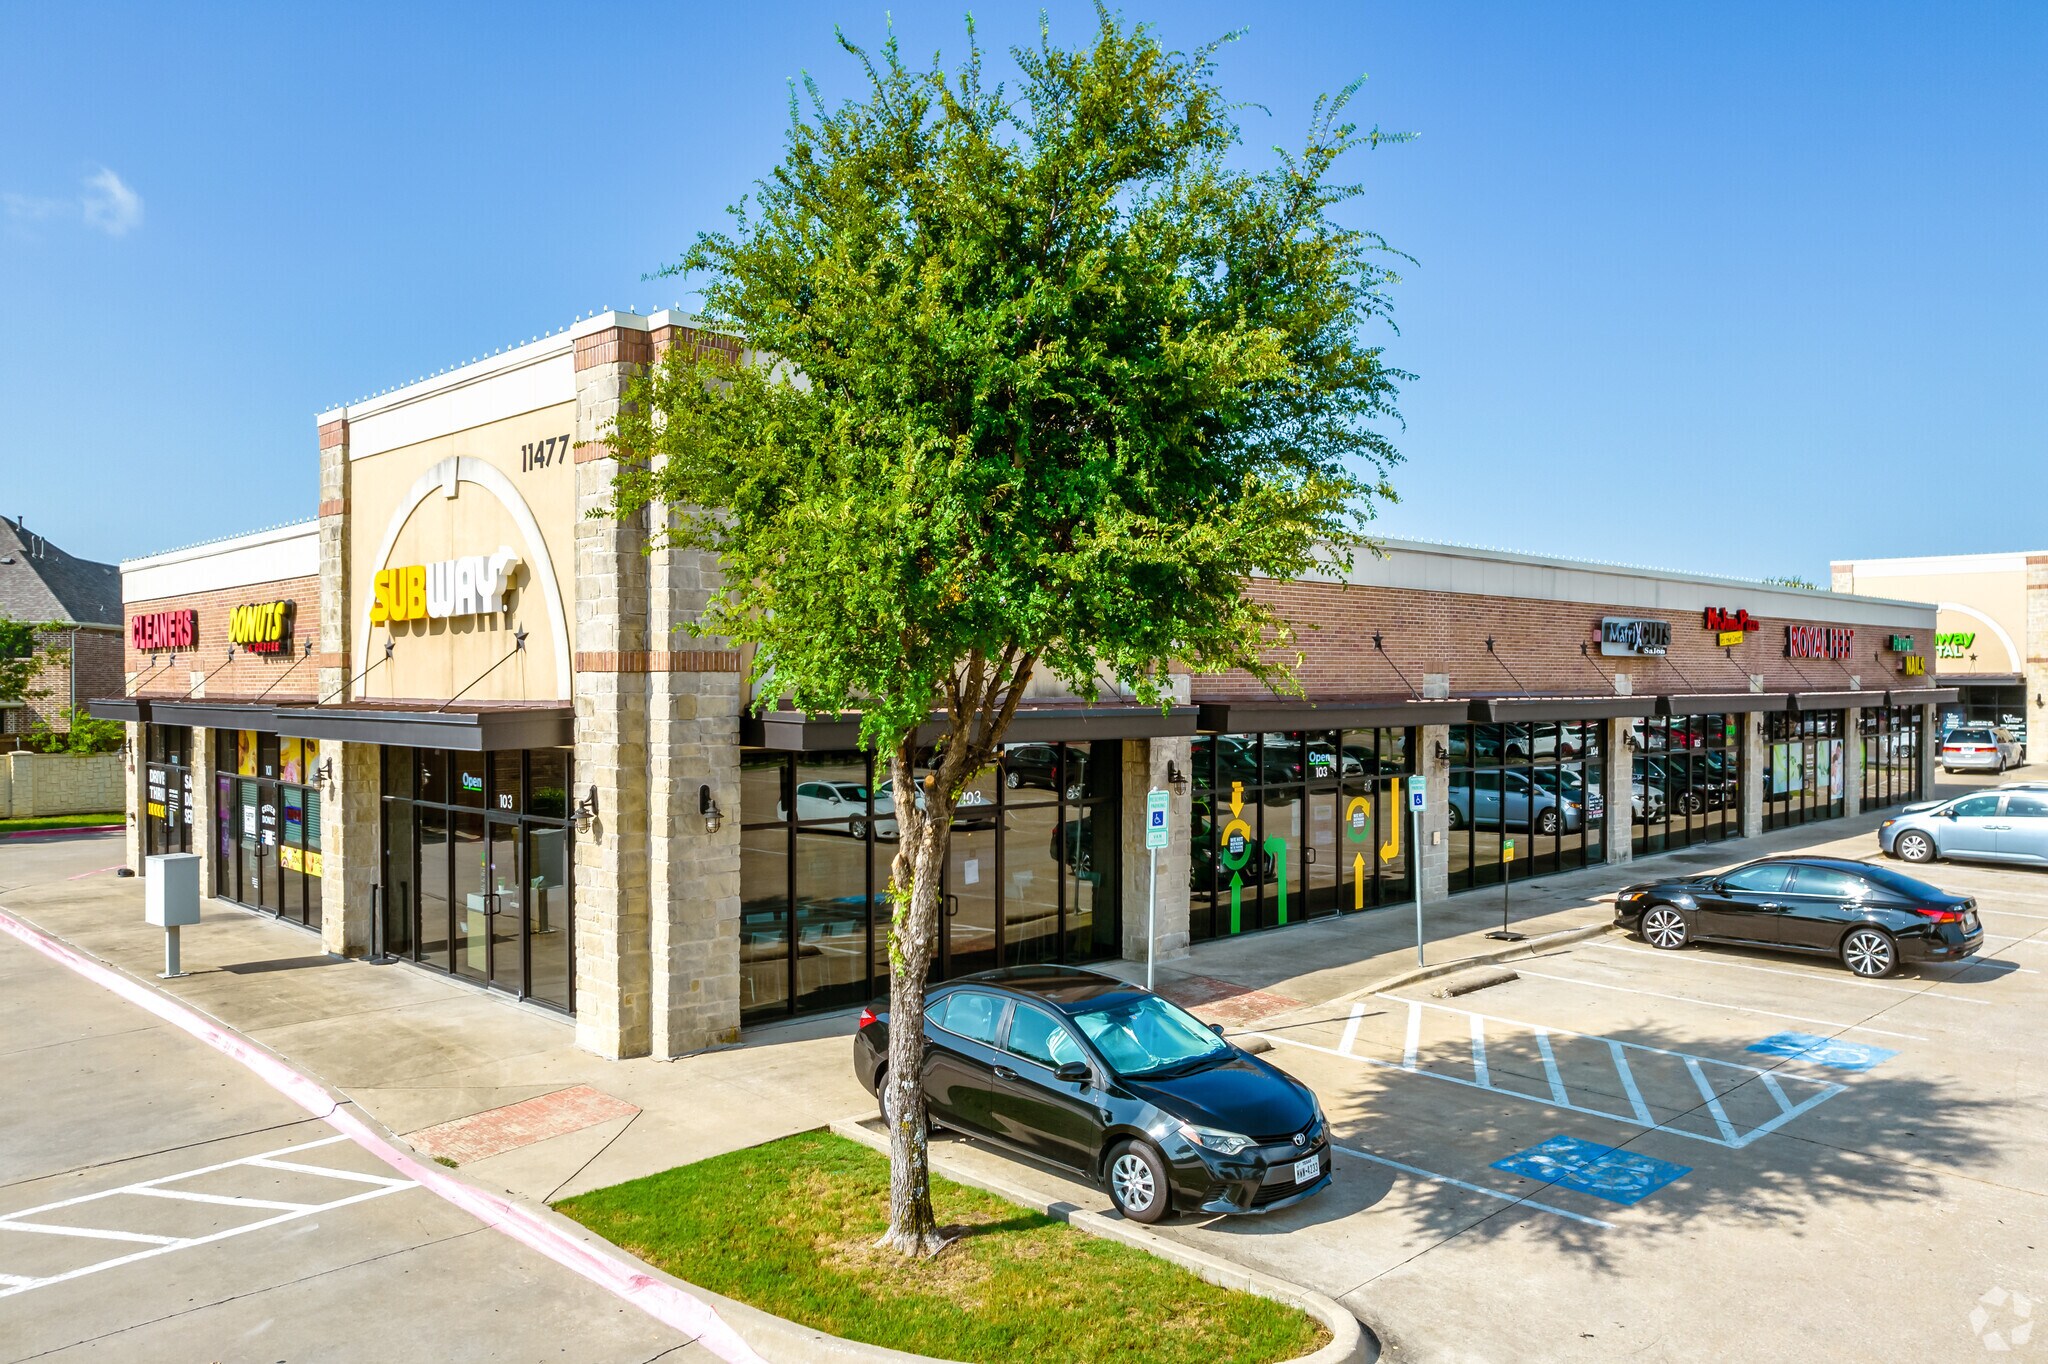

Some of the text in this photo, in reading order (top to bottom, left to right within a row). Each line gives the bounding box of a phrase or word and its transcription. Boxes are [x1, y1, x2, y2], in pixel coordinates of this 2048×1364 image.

[521, 434, 570, 472] 11477
[370, 546, 518, 622] SUBWAY
[132, 609, 193, 649] CLEANERS
[228, 601, 284, 643] DONUTS
[1643, 646, 1666, 655] Salon
[1790, 625, 1855, 659] ROYAL FEET
[1906, 656, 1925, 675] NAILS
[1309, 751, 1330, 766] Open
[149, 768, 166, 785] DRIVE
[462, 772, 482, 789] Open
[1315, 766, 1328, 778] 103
[149, 785, 166, 802] THRU
[499, 794, 513, 810] 103
[962, 790, 981, 805] 103
